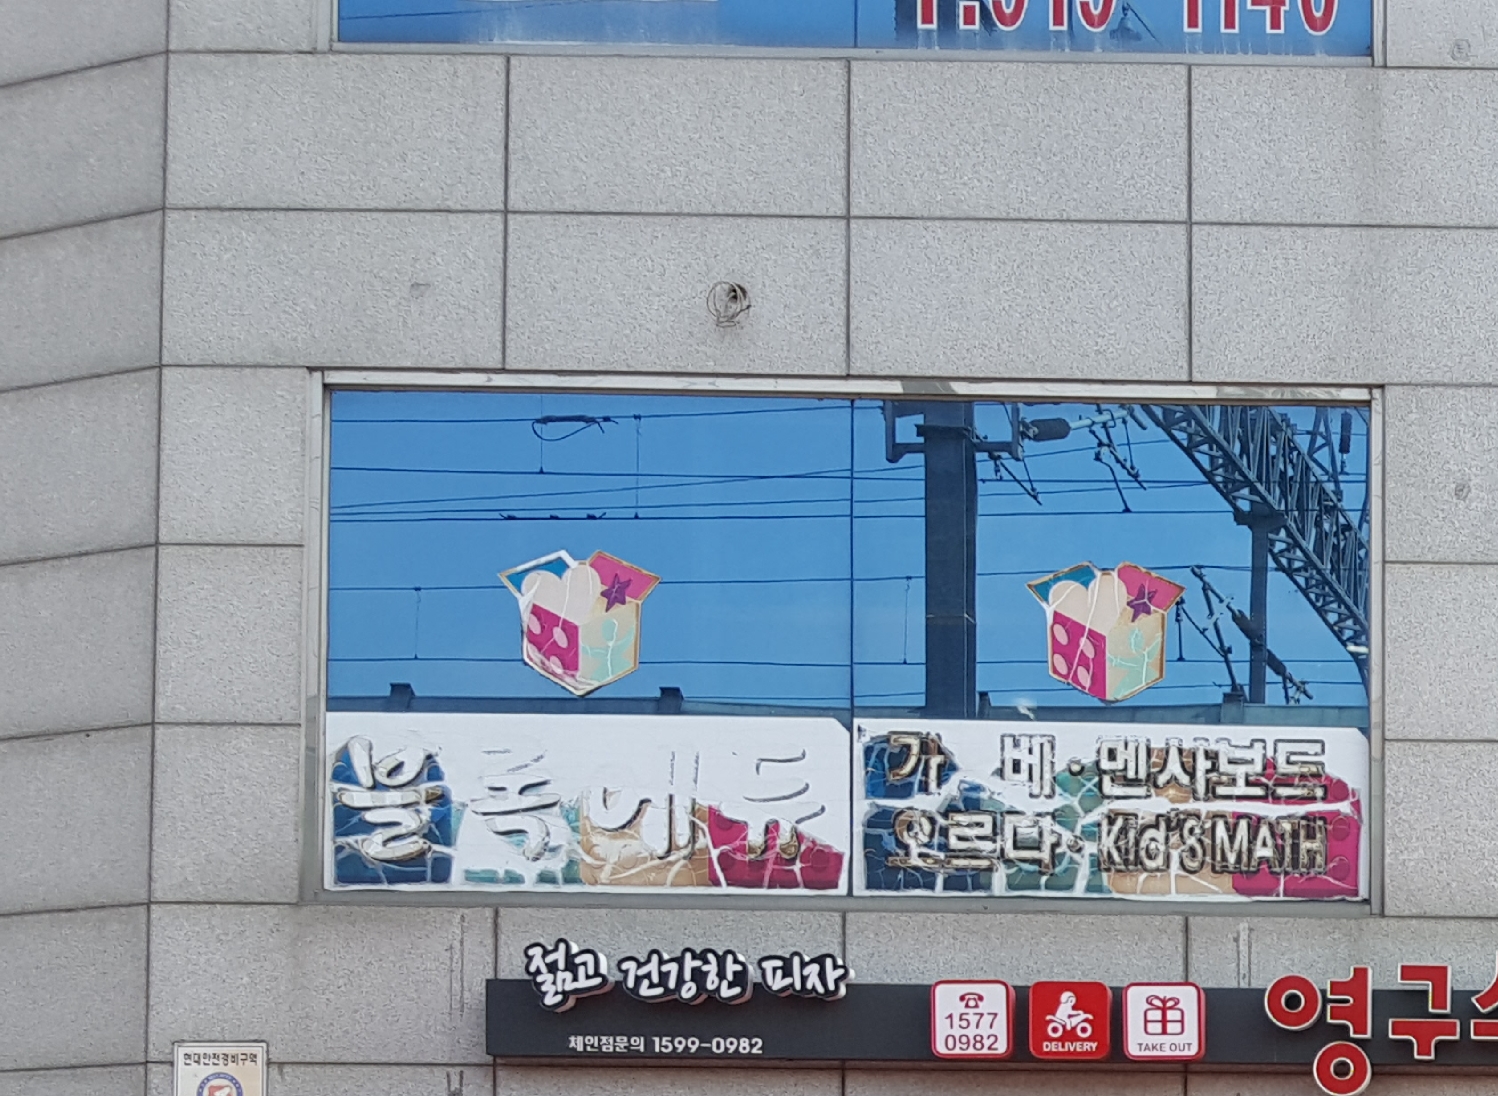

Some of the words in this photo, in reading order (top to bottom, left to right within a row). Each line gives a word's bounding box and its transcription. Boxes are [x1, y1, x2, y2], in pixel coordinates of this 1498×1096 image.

[525, 937, 611, 1012] 젊고
[618, 947, 753, 1005] 건강한
[760, 951, 853, 1000] 피자
[944, 1012, 999, 1030] 1577
[568, 1034, 645, 1054] 체인점문의
[651, 1036, 764, 1055] 1599-0982
[944, 1034, 999, 1052] 0982
[1042, 1041, 1099, 1053] DELIVERY
[1137, 1042, 1167, 1053] TAKE
[1169, 1042, 1193, 1053] OUT
